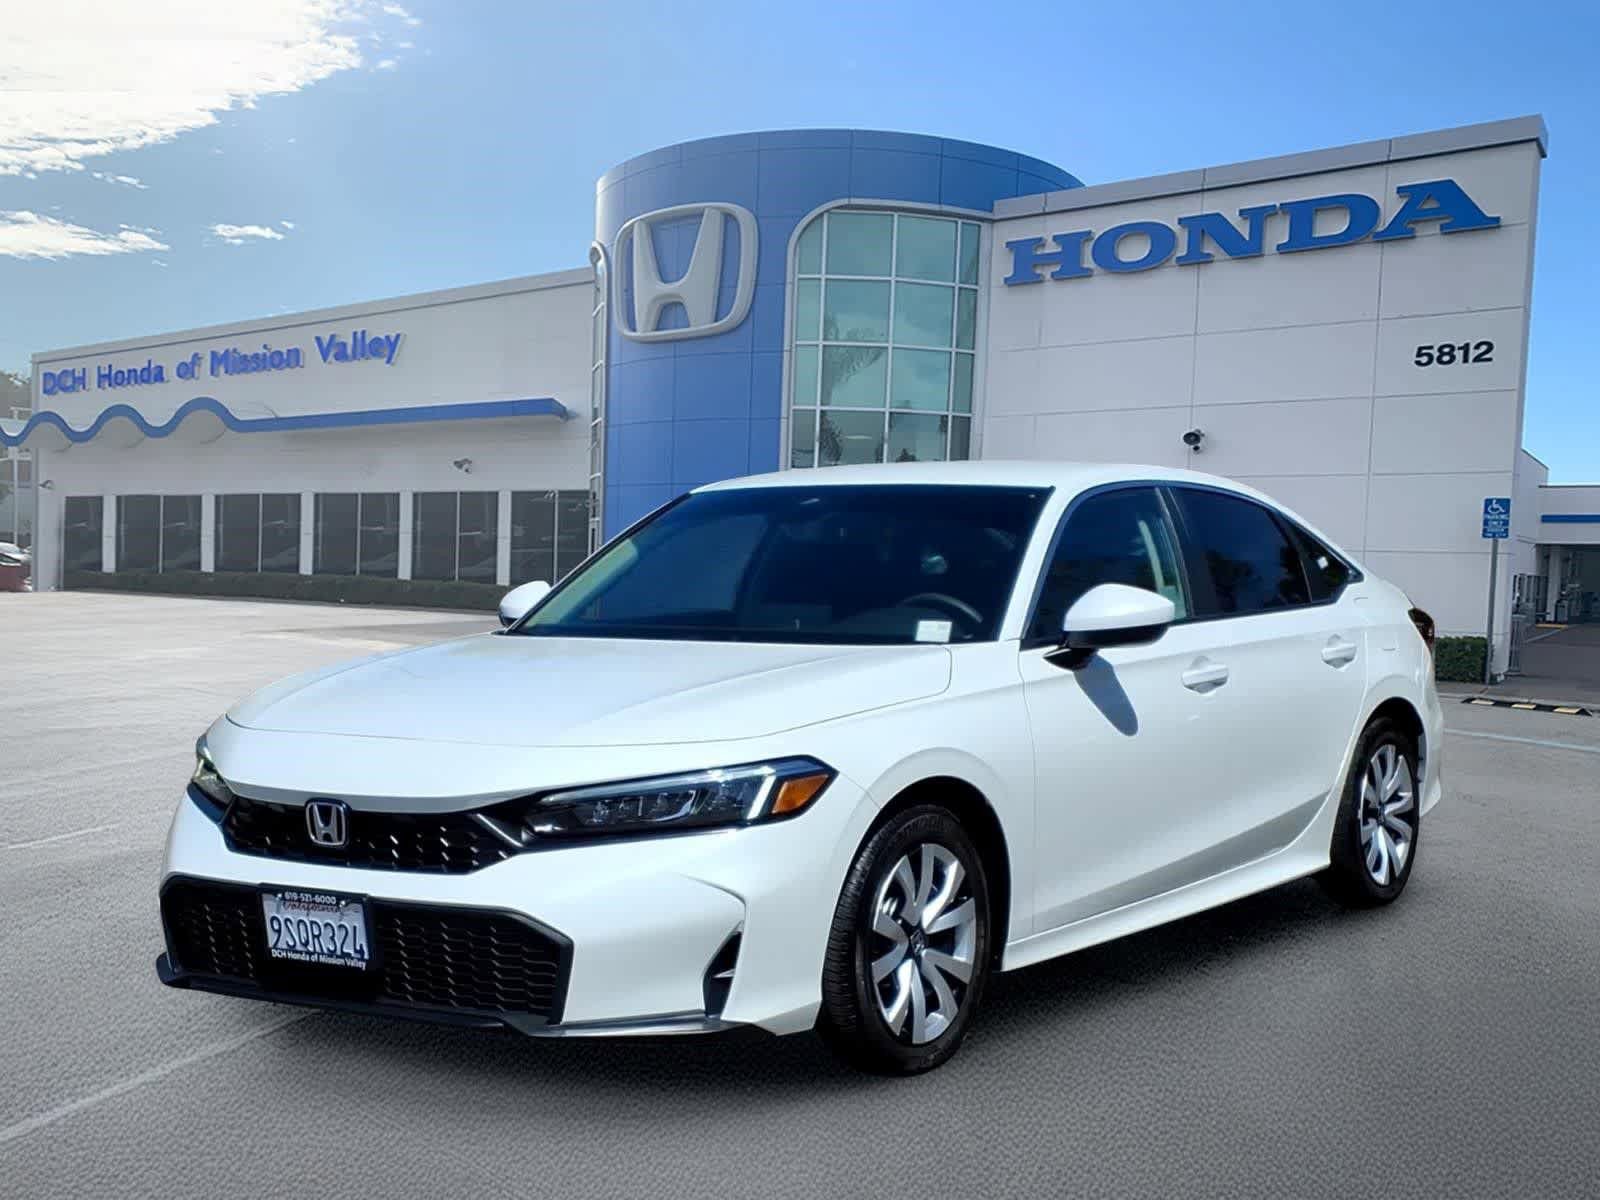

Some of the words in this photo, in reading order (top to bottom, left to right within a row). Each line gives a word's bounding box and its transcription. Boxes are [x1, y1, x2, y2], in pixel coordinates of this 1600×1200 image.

[1003, 178, 1502, 286] HONDA
[42, 370, 87, 395] DCH
[97, 359, 165, 389] Honda
[176, 352, 203, 381] of
[210, 344, 304, 378] Mission
[314, 329, 403, 367] Valley
[1413, 340, 1494, 368] 5812
[269, 915, 366, 960] 9SQR324
[271, 948, 286, 959] DCH
[287, 950, 310, 962] Honda
[310, 953, 318, 962] of
[345, 957, 366, 971] Valley
